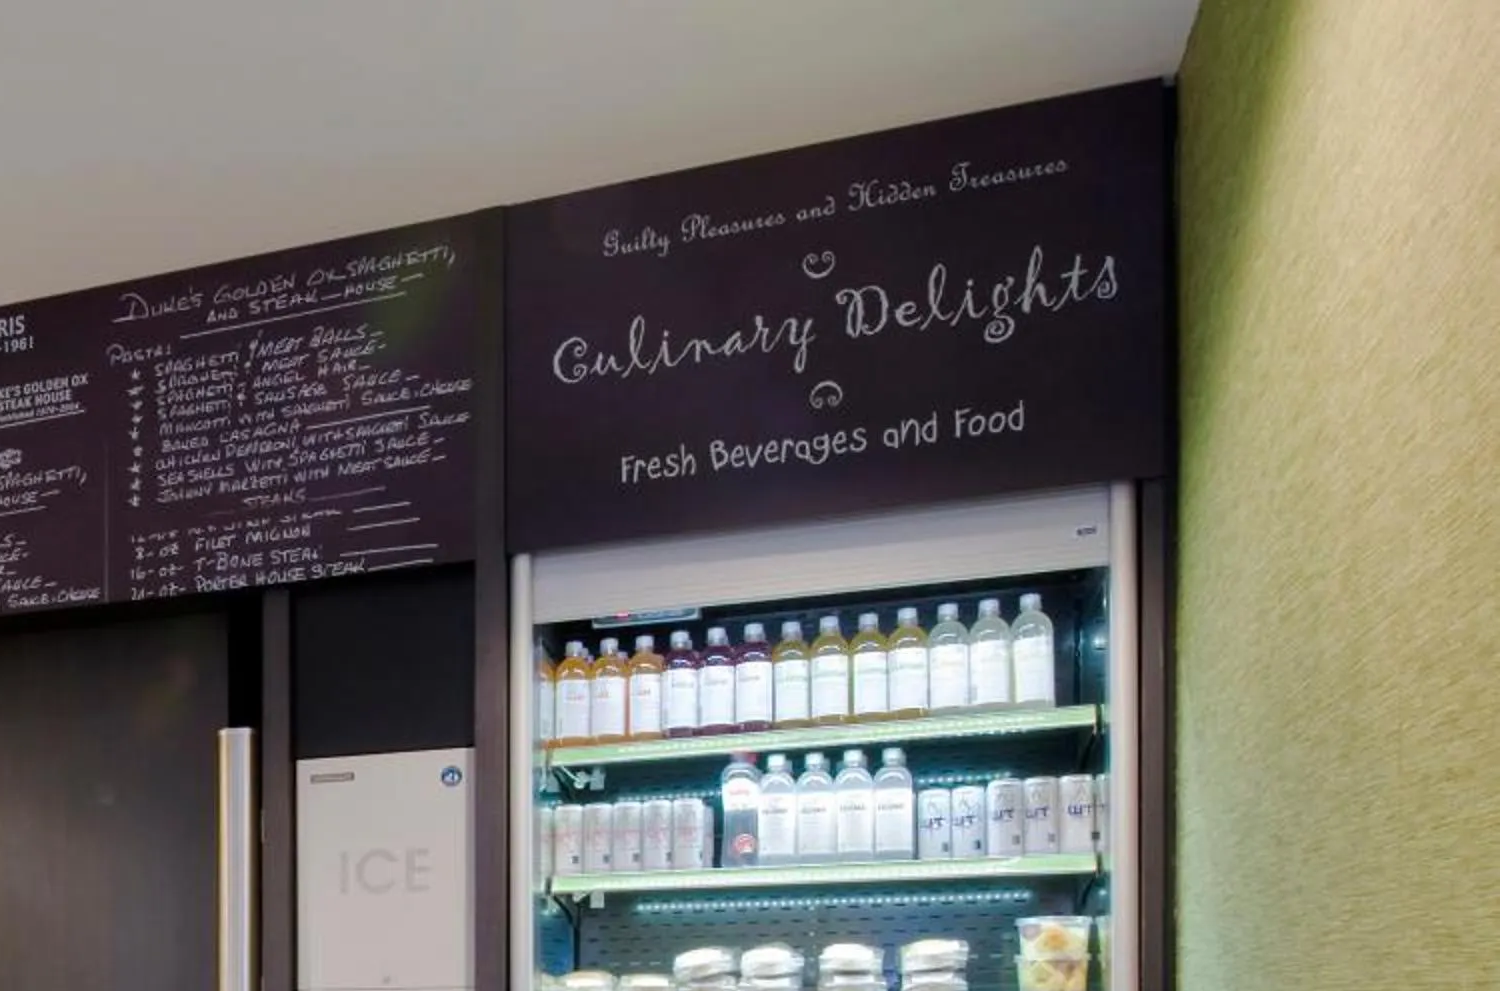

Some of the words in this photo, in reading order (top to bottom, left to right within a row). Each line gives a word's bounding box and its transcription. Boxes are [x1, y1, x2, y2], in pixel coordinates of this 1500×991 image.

[602, 229, 670, 258] Guilty
[680, 213, 786, 242] Pleasures
[796, 195, 837, 223] and
[847, 178, 938, 212] Hidden
[948, 160, 1069, 194] Treasures
[552, 315, 815, 384] Culinary
[834, 244, 1120, 343] Delights
[620, 444, 697, 484] Fresh
[710, 425, 868, 470] Beverages
[883, 410, 938, 451] and
[953, 399, 1025, 440] Food
[339, 847, 432, 895] ICE
